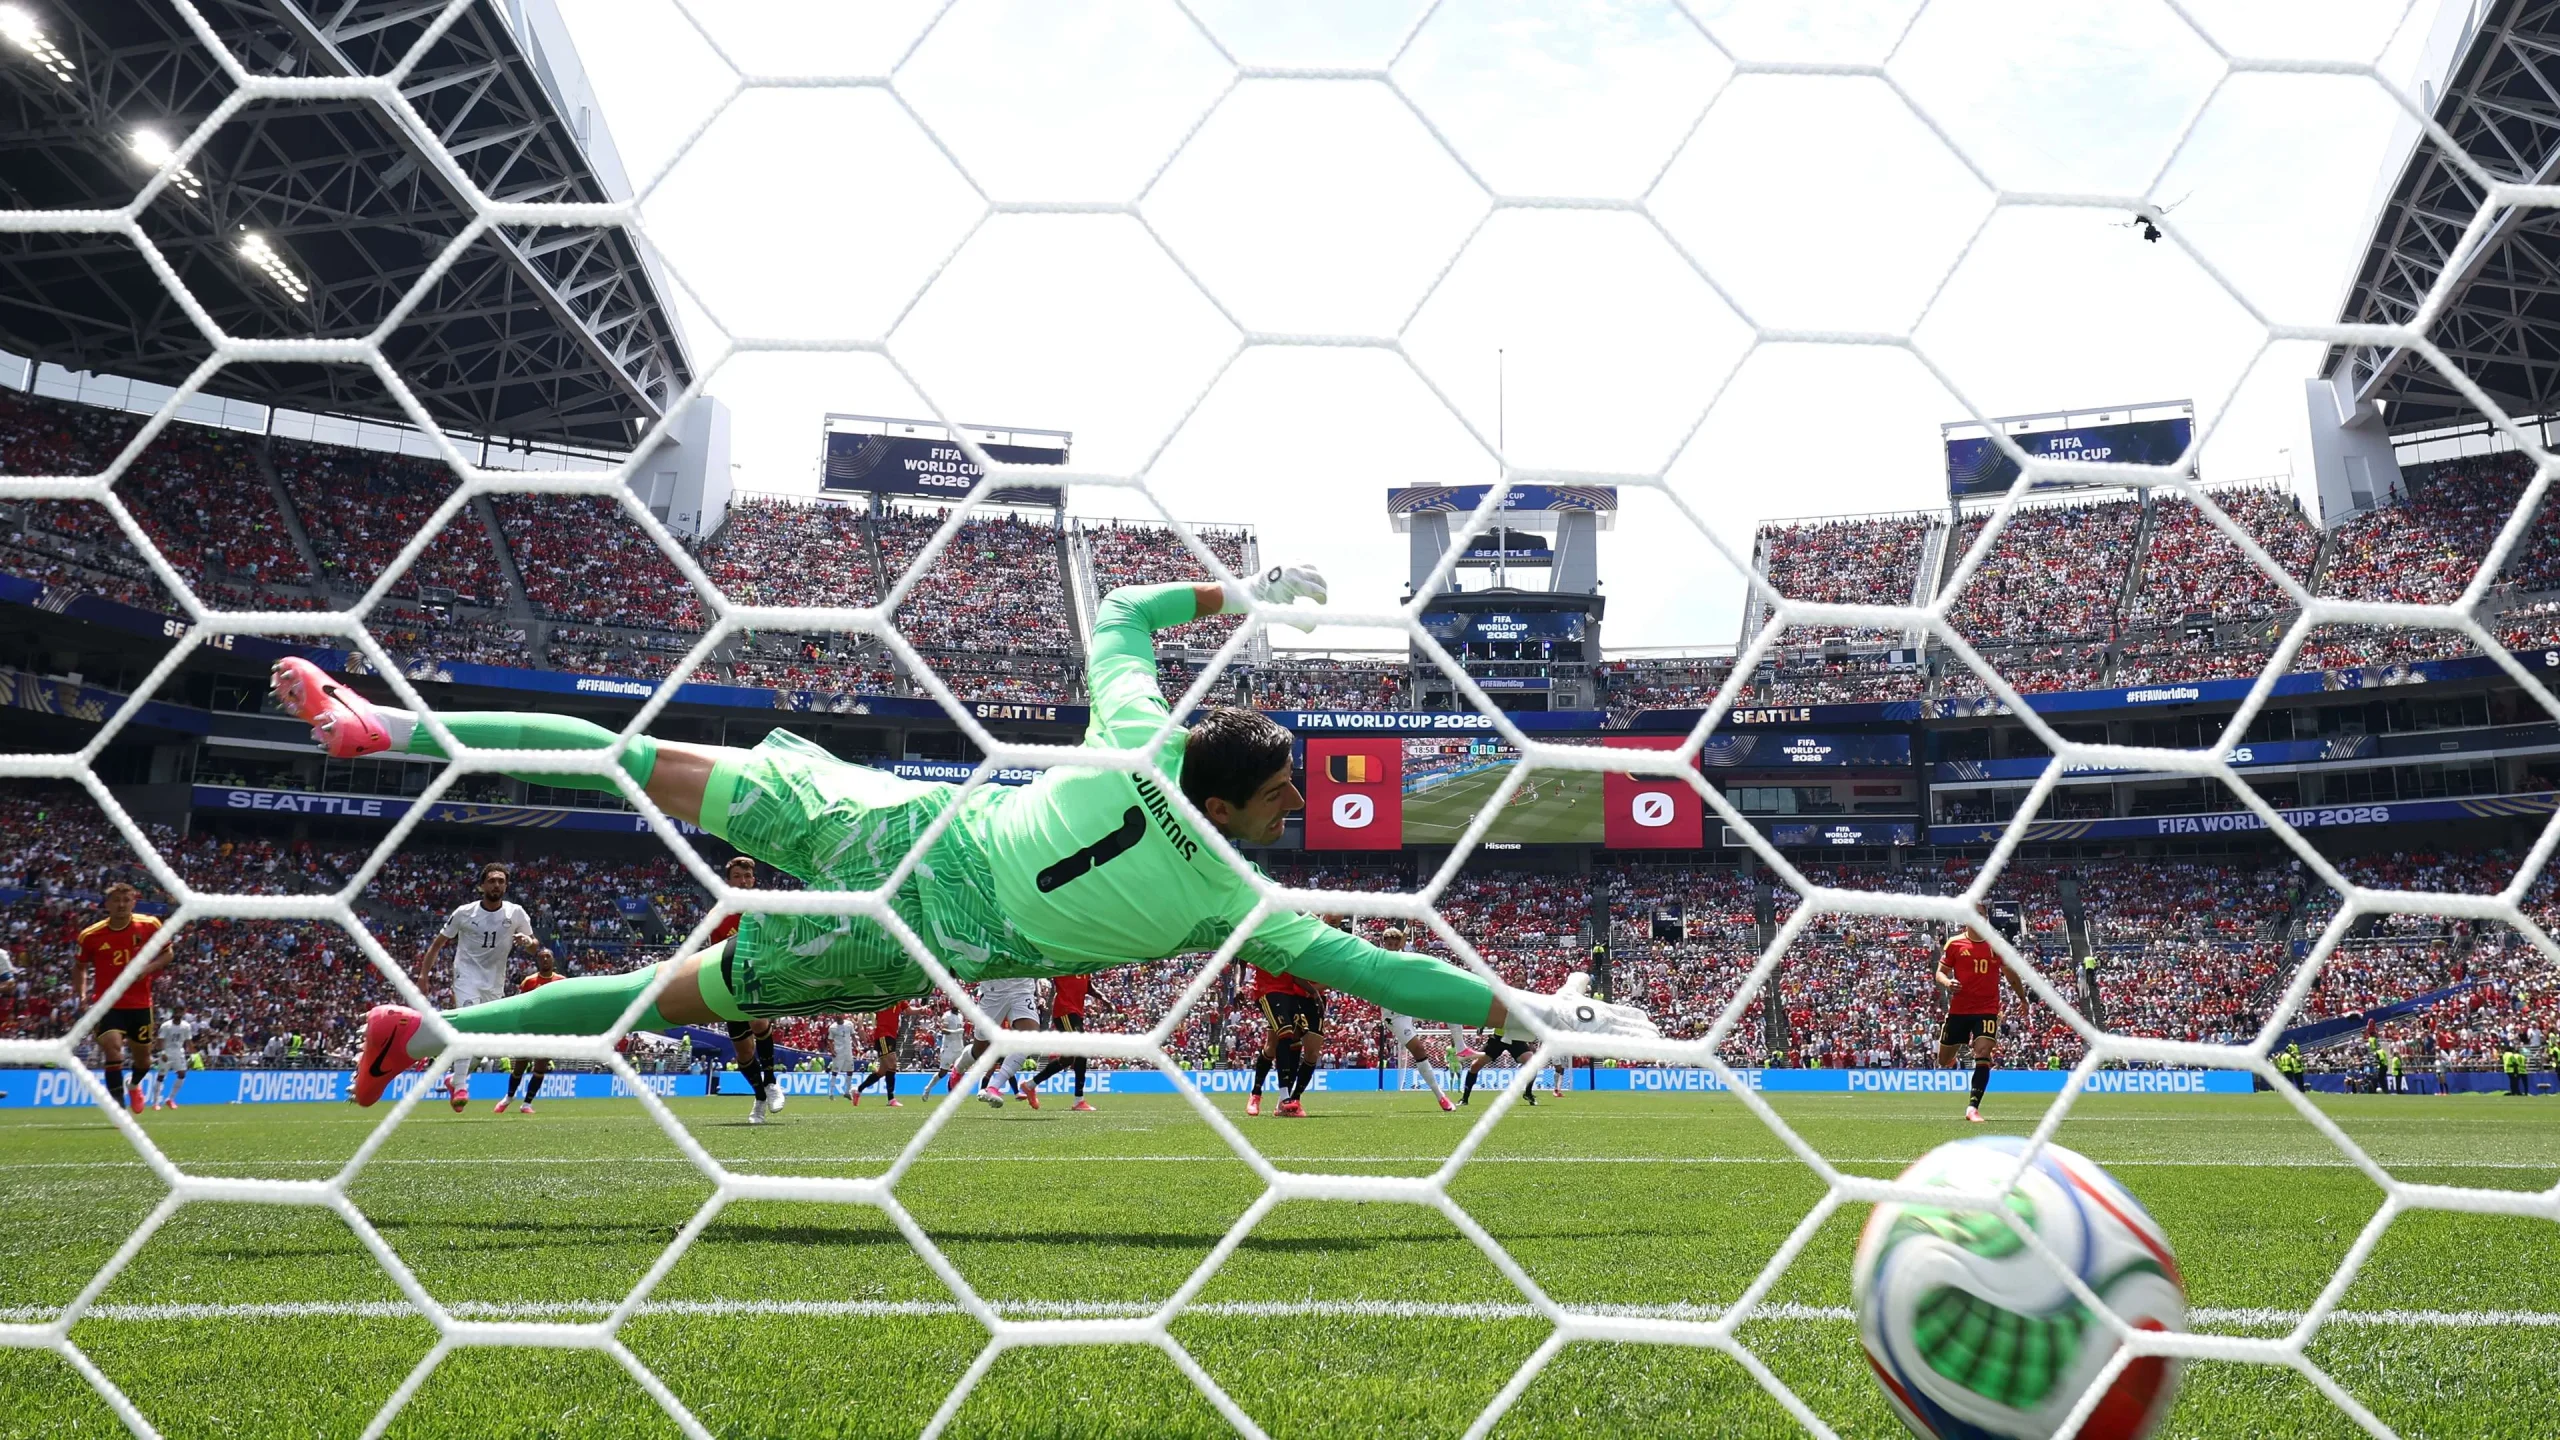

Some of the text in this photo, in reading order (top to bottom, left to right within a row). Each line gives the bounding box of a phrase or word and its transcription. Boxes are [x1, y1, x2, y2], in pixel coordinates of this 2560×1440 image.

[2051, 437, 2083, 450] FIFA
[931, 448, 962, 461] FIFA
[2081, 447, 2111, 461] CUP
[904, 459, 957, 475] WORLD
[919, 474, 970, 488] 2026
[576, 679, 652, 698] #FIFAWorldCup
[1480, 680, 1524, 689] #FIFAWorldCup
[2126, 687, 2199, 703] #FIFAWorldCup
[976, 704, 1056, 721] SEATTLE
[1732, 708, 1811, 724] SEATTLE
[1297, 714, 1492, 728] FIFA WORLD CUP 2026
[1792, 754, 1822, 762] 2026
[894, 765, 921, 777] FIFA
[923, 766, 970, 778] WORLD
[227, 791, 382, 817] SEATTLE
[2158, 818, 2200, 834] FIFA
[2319, 806, 2390, 826] 2026
[1036, 805, 1147, 894] 1
[481, 931, 497, 949] 11
[113, 949, 130, 966] 21
[1973, 959, 1988, 974] 10
[1982, 1020, 1995, 1034] 10
[238, 1072, 338, 1101] POWERADE
[2387, 1075, 2409, 1090] FIA
